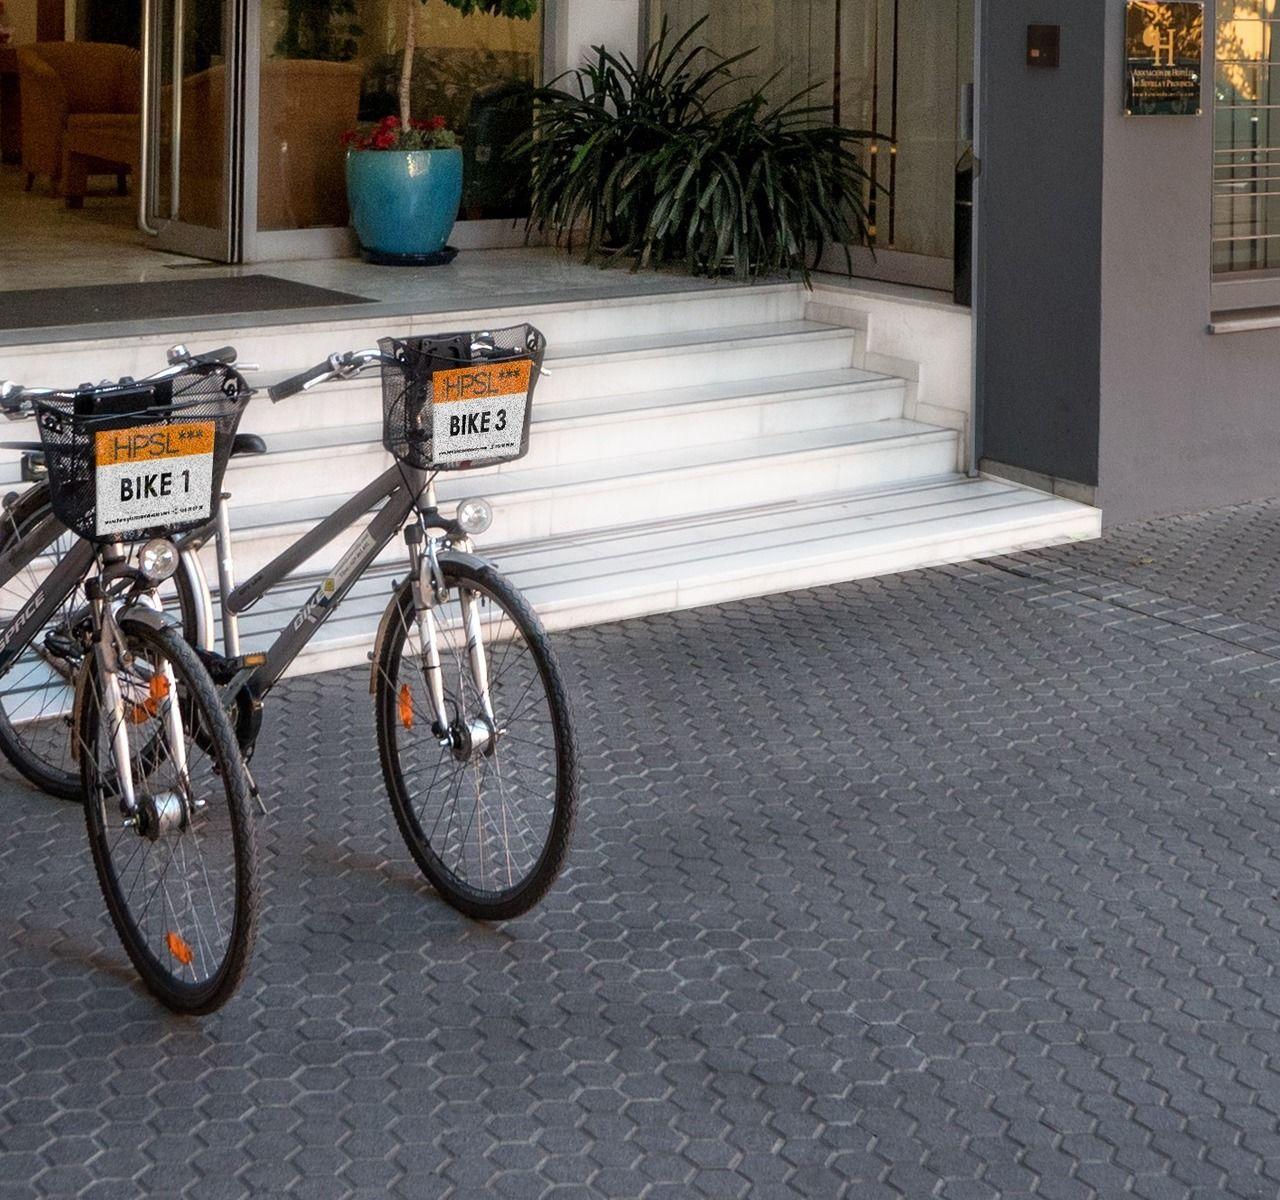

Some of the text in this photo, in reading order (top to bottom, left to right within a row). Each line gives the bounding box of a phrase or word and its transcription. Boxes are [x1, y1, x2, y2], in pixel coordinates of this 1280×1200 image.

[450, 408, 507, 436] BIKE 3
[120, 469, 190, 502] BIKE 1
